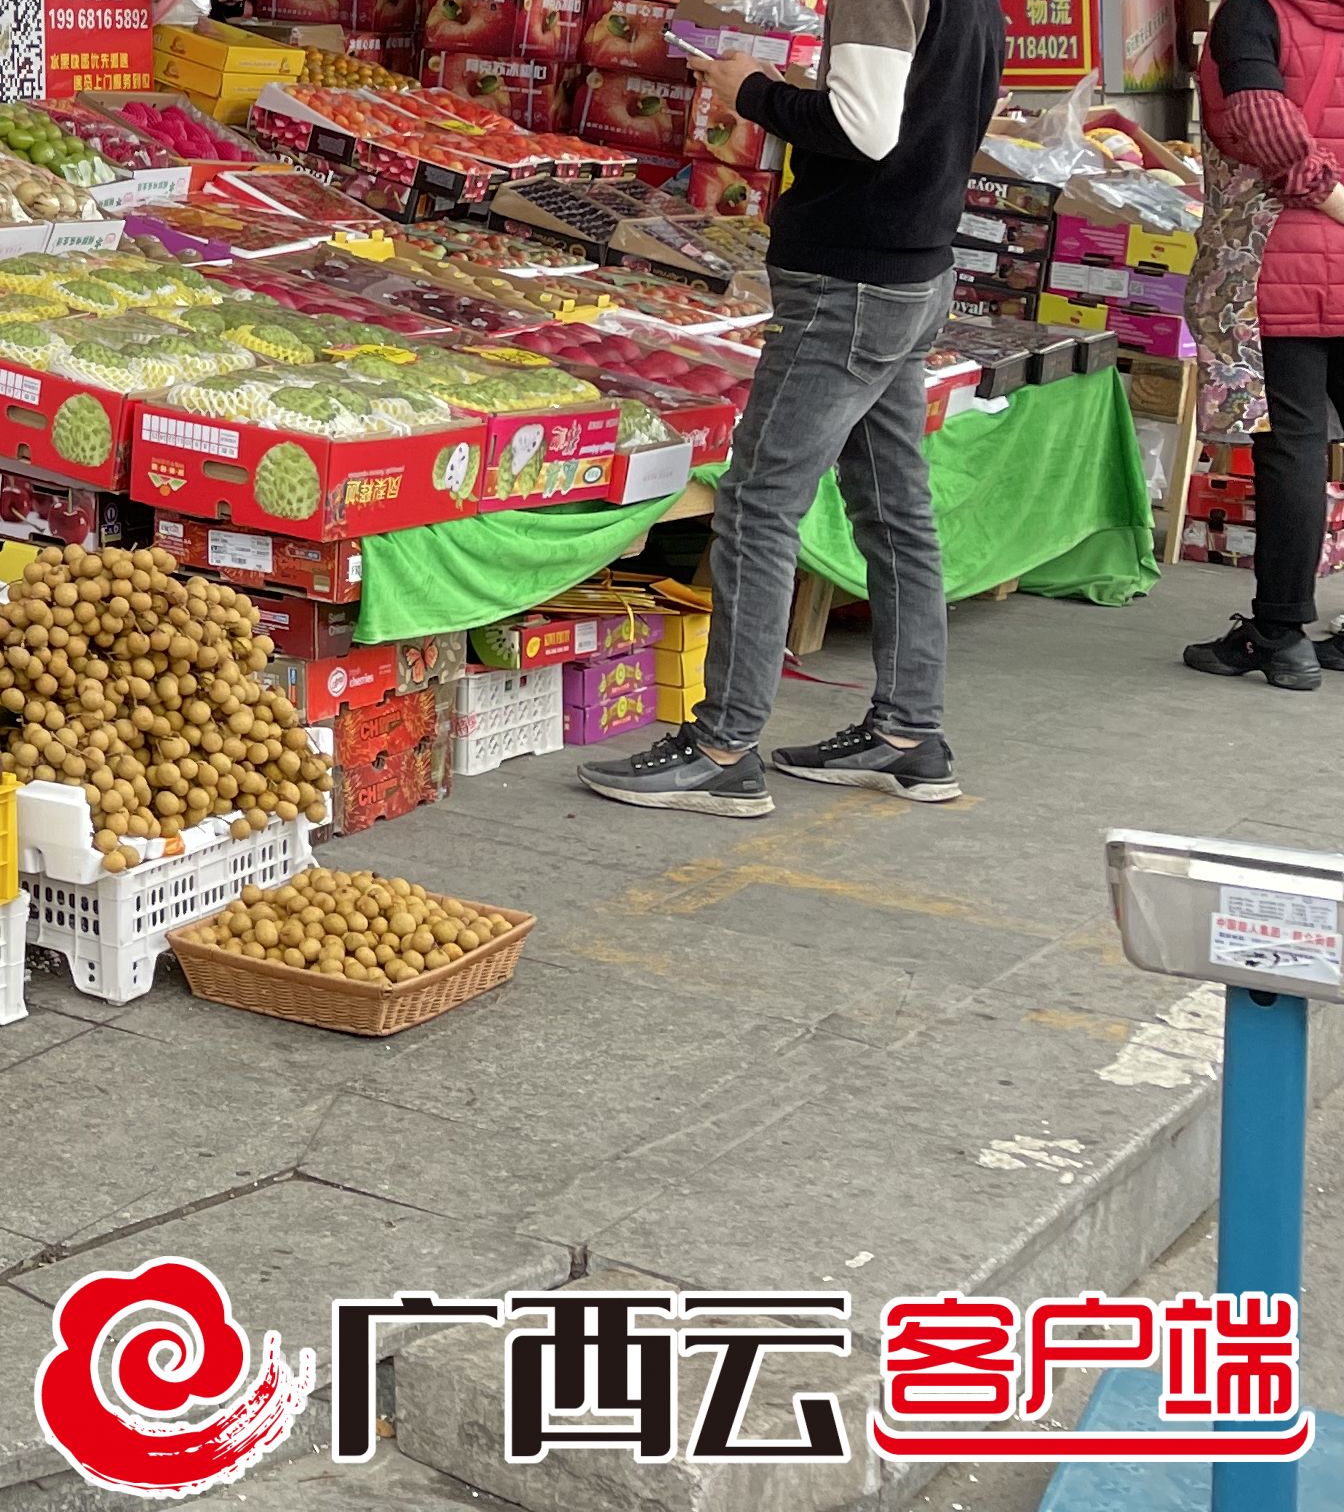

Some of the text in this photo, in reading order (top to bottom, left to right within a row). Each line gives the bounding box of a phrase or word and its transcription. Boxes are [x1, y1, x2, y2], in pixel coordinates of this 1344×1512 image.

[48, 7, 150, 32] 199 6816 5892
